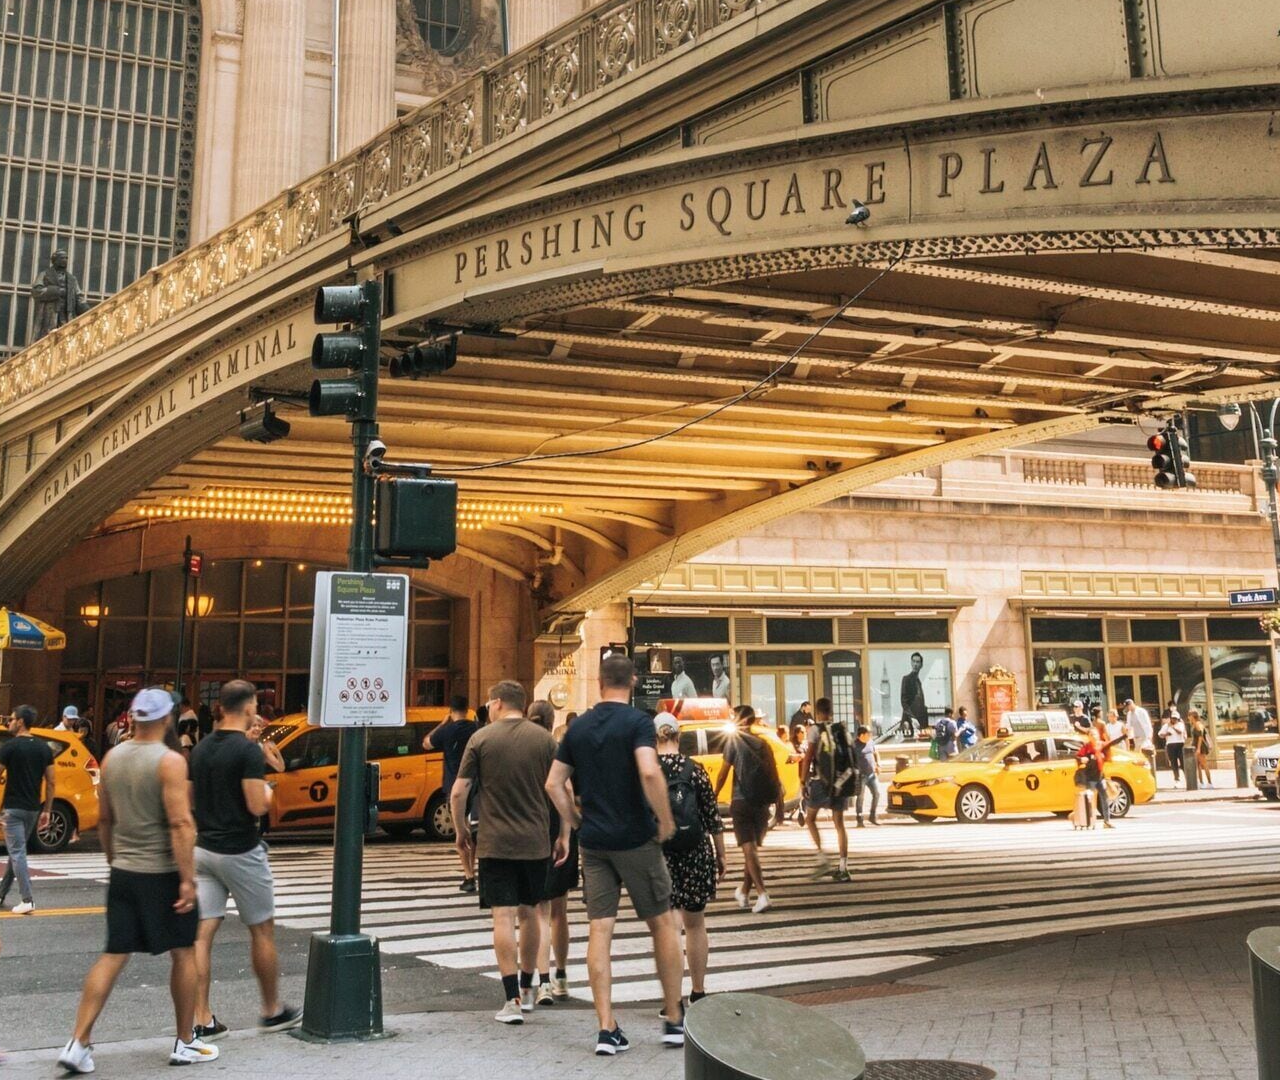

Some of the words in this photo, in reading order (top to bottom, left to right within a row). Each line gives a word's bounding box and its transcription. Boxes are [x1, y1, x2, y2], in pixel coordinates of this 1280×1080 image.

[453, 203, 647, 284] PERSHING
[679, 160, 887, 235] SQUARE
[937, 130, 1176, 199] PLAZA
[43, 452, 93, 506] GRAND
[102, 387, 177, 458] CENTRAL
[188, 322, 297, 401] TERMINAL
[1237, 594, 1253, 603] Park
[1254, 593, 1267, 601] Ave
[1068, 671, 1079, 680] For
[1080, 672, 1089, 680] all
[1089, 671, 1101, 680] the
